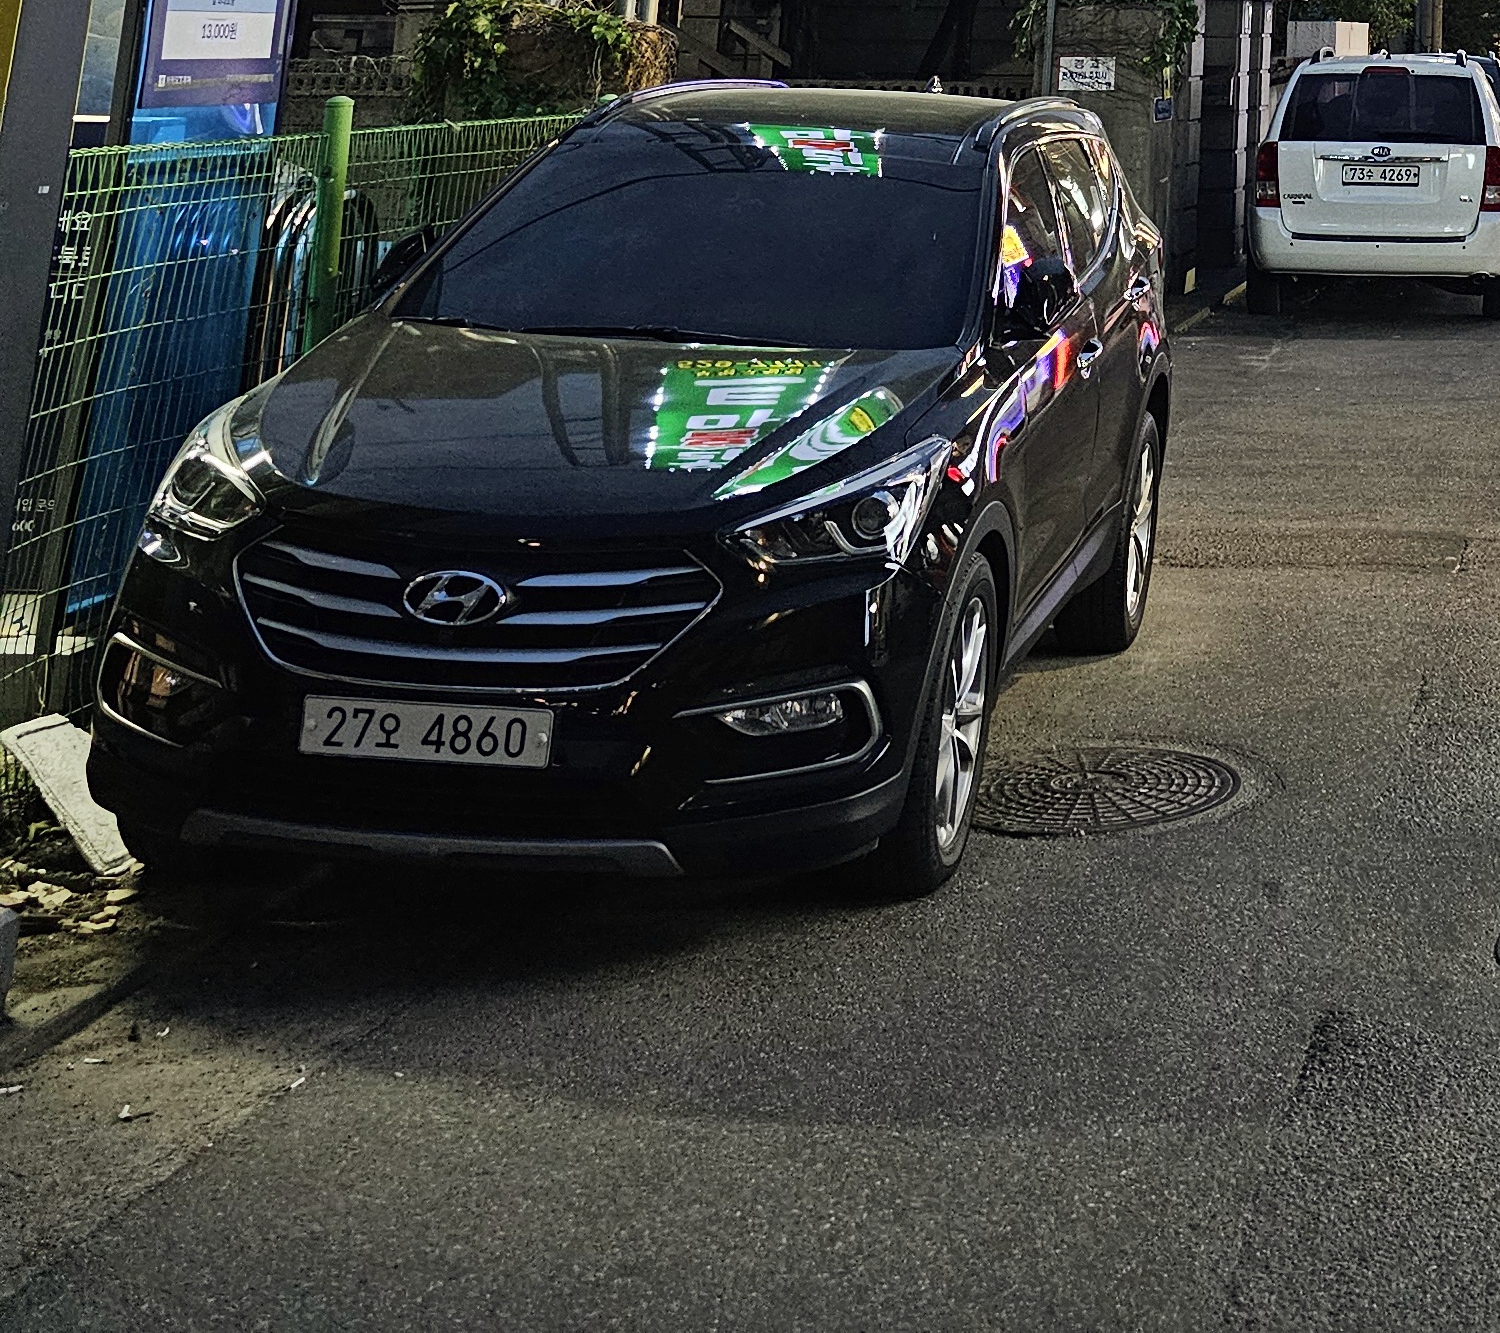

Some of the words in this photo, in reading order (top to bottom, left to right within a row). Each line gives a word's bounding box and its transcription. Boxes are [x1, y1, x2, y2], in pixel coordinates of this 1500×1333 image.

[201, 22, 238, 40] 13,000원
[1349, 168, 1374, 181] 73수
[1380, 169, 1412, 181] 4269
[321, 706, 402, 749] 27오
[421, 713, 528, 759] 4860
